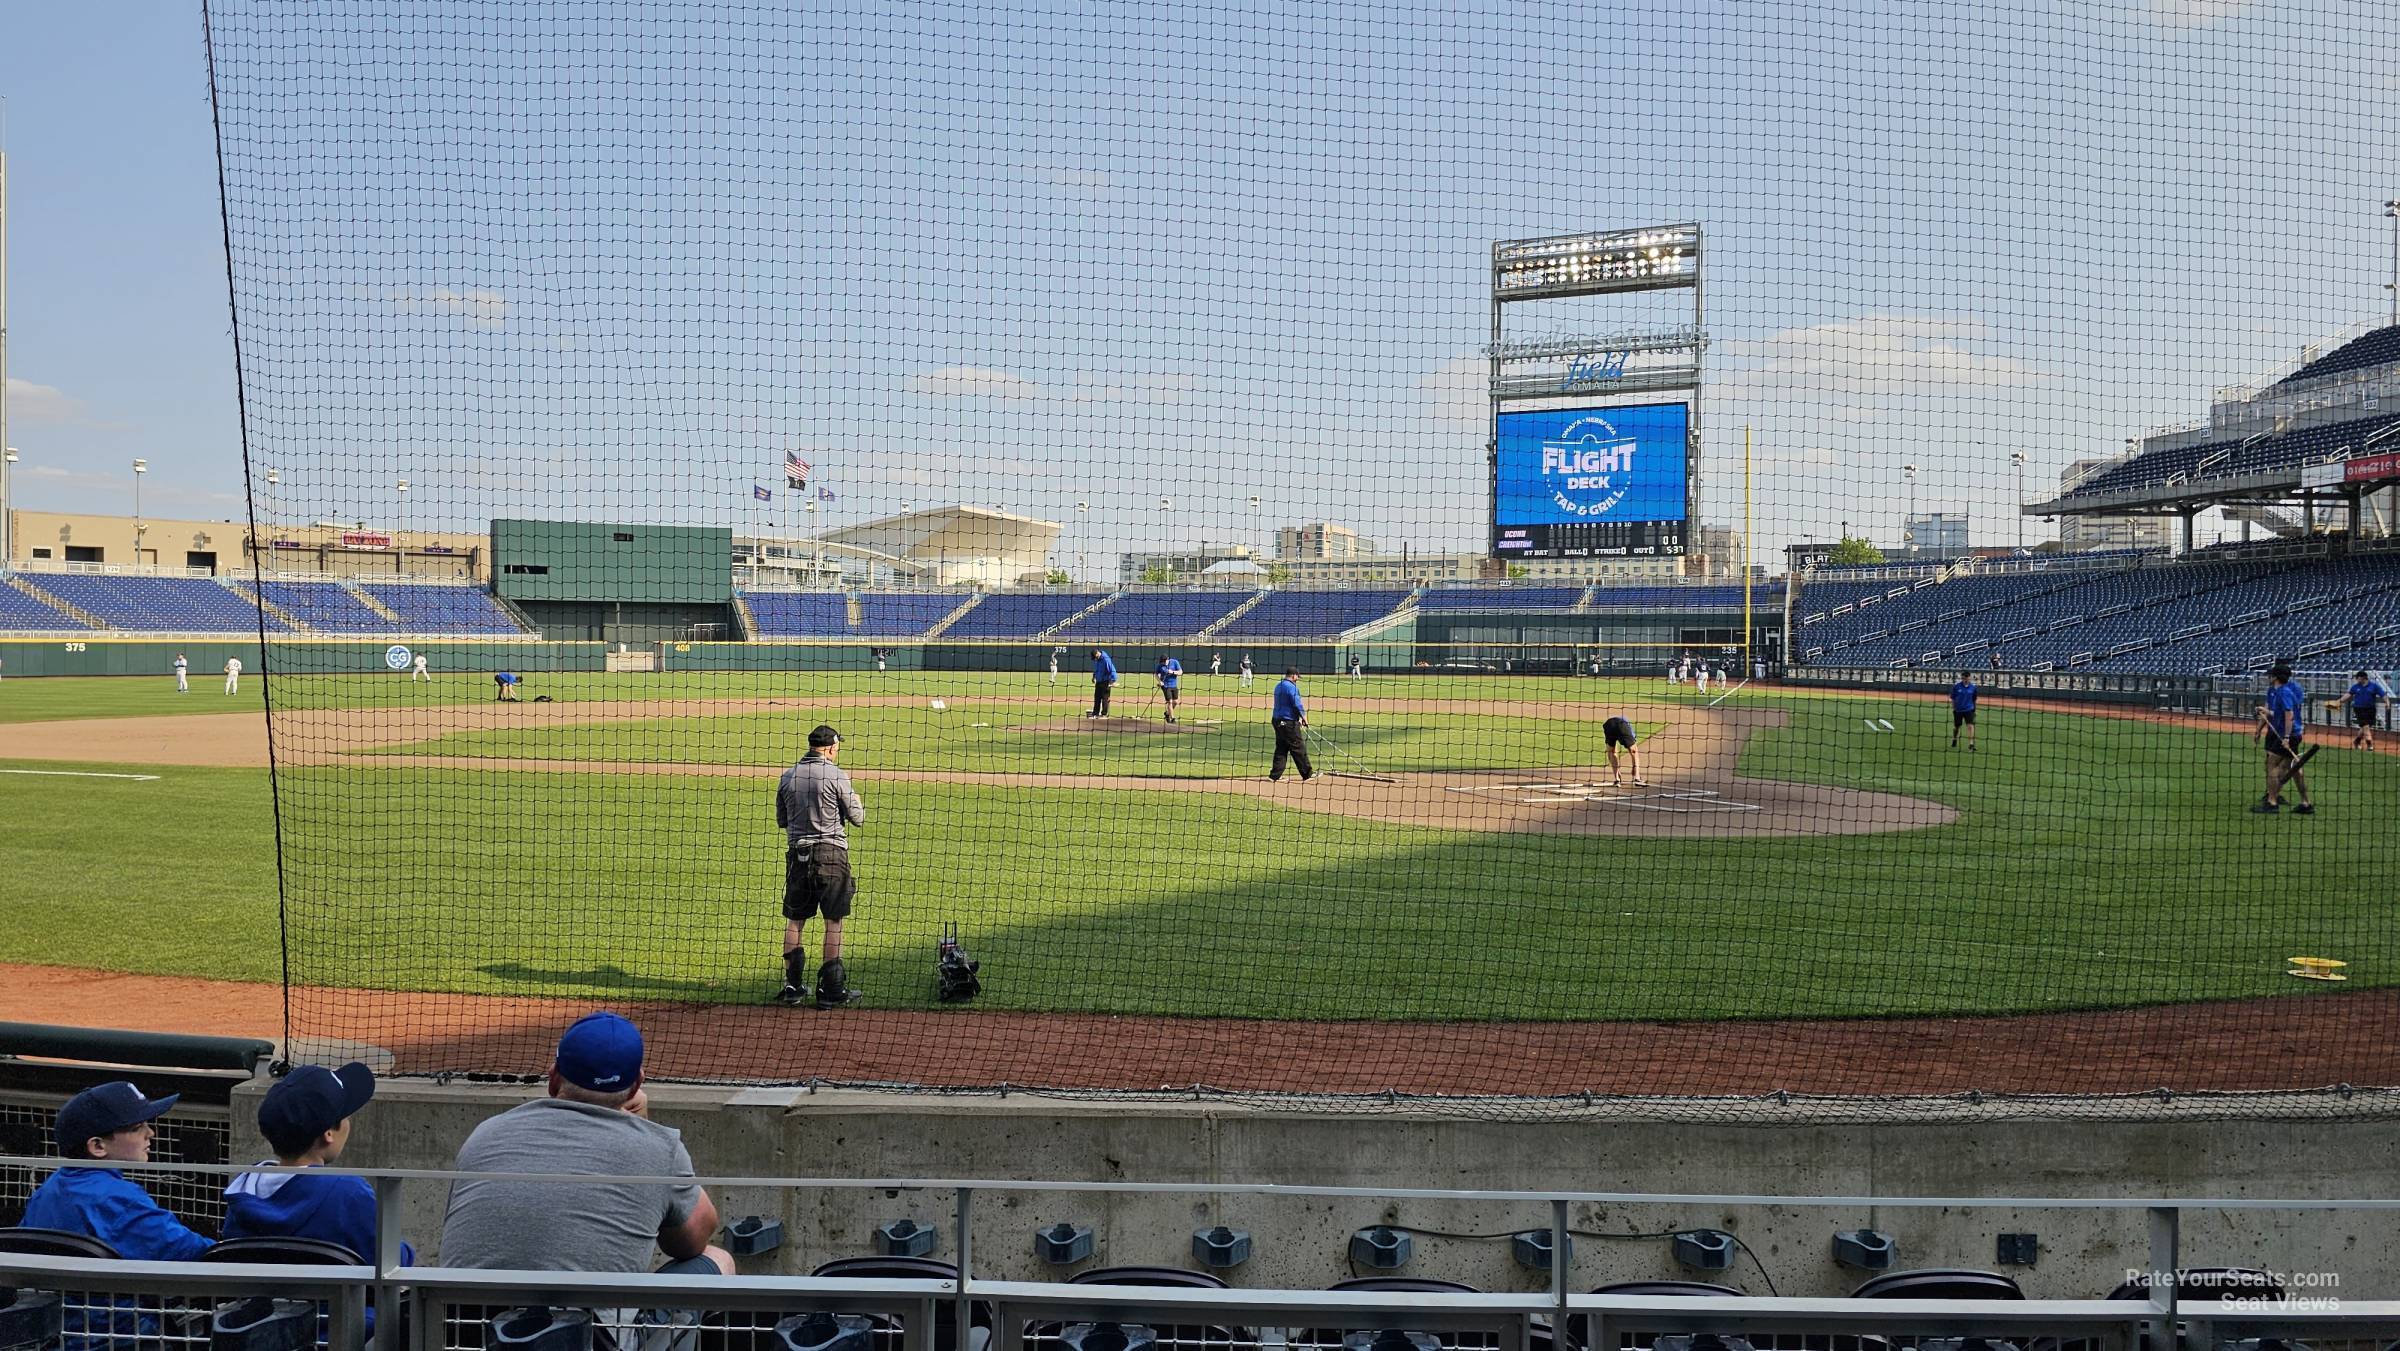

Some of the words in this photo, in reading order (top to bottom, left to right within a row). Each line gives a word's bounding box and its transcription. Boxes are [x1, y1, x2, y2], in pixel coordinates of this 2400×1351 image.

[1572, 380, 1620, 391] OMAHA
[1585, 416, 1617, 436] NEBRASKA
[1542, 442, 1637, 475] FLIGHT
[1567, 476, 1611, 490] DECK
[1553, 491, 1577, 512] TAP
[1577, 506, 1588, 516] &
[1589, 491, 1625, 516] GRILL
[1504, 530, 1527, 538] UCONN
[1564, 548, 1582, 556] BALL
[1594, 547, 1621, 555] STRIKE
[65, 642, 86, 652] 375
[675, 644, 691, 652] 408
[1054, 646, 1067, 654] 375
[389, 652, 408, 663] CG
